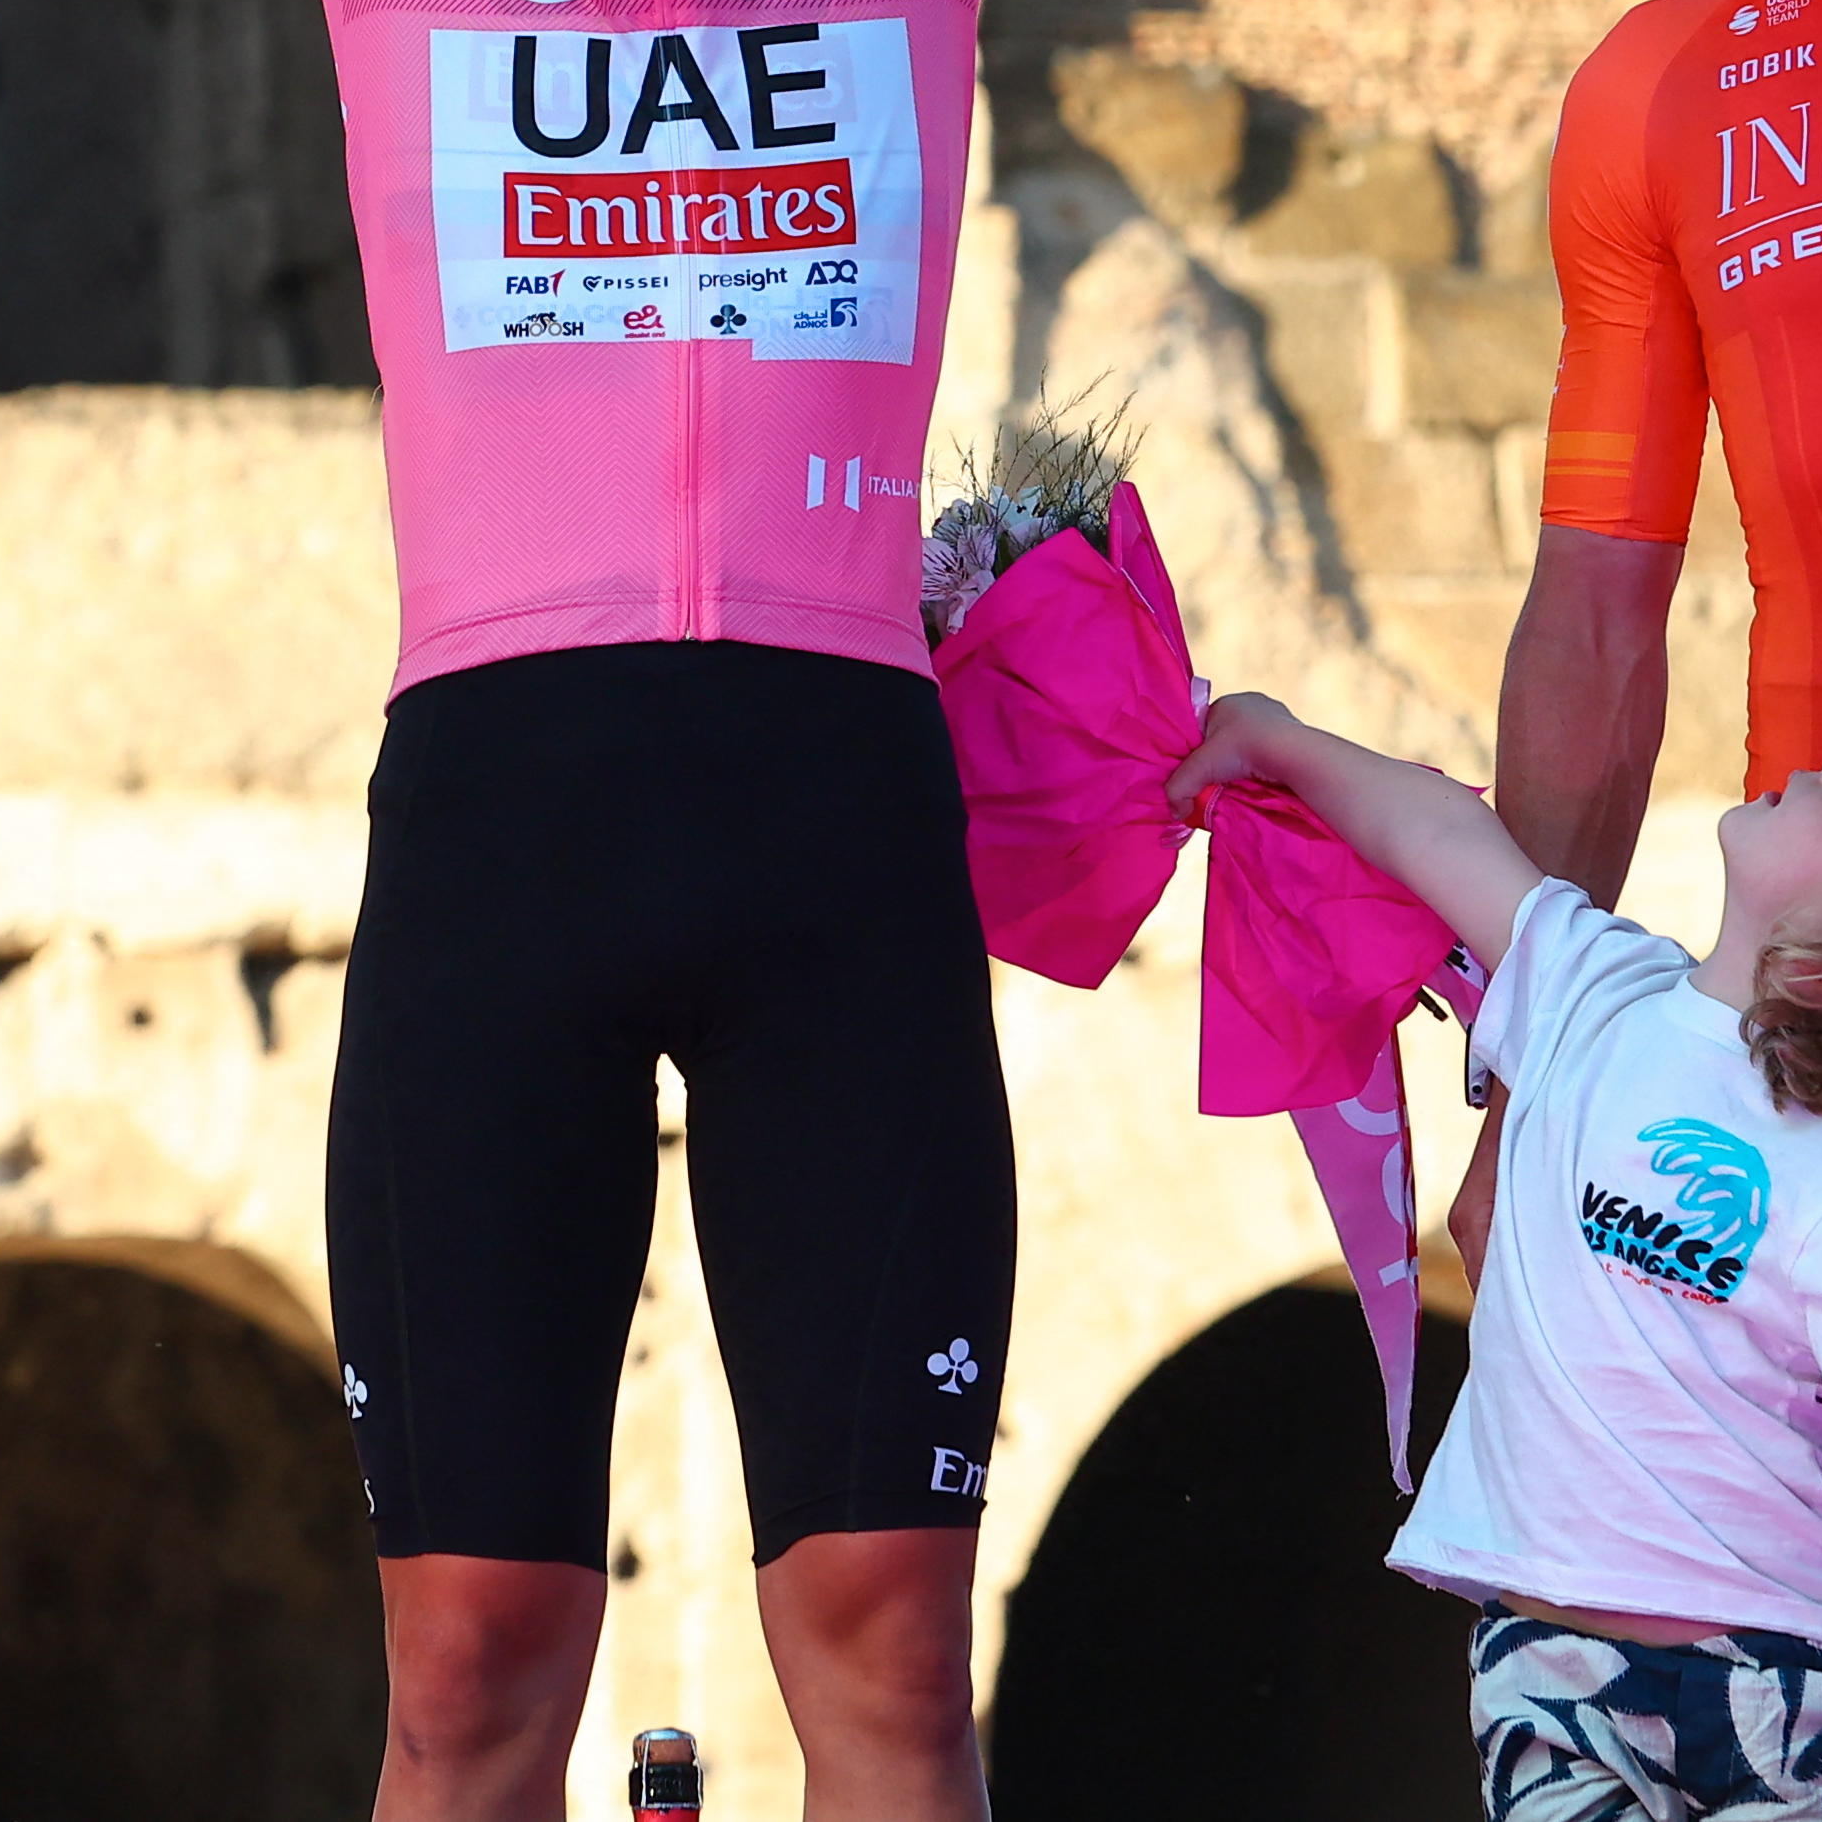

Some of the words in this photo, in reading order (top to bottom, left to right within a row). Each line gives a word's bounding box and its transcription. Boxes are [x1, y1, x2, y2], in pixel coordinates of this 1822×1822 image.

[1766, 9, 1801, 28] TEAM
[1719, 43, 1817, 90] GOBIK
[512, 22, 837, 159] UAE
[514, 180, 847, 248] Emirates
[505, 276, 550, 295] FAB
[604, 275, 669, 290] PISSEI
[698, 267, 788, 292] presight
[794, 320, 828, 329] ADNOC
[1582, 1180, 1745, 1290] VENICE
[1583, 1225, 1608, 1252] OS
